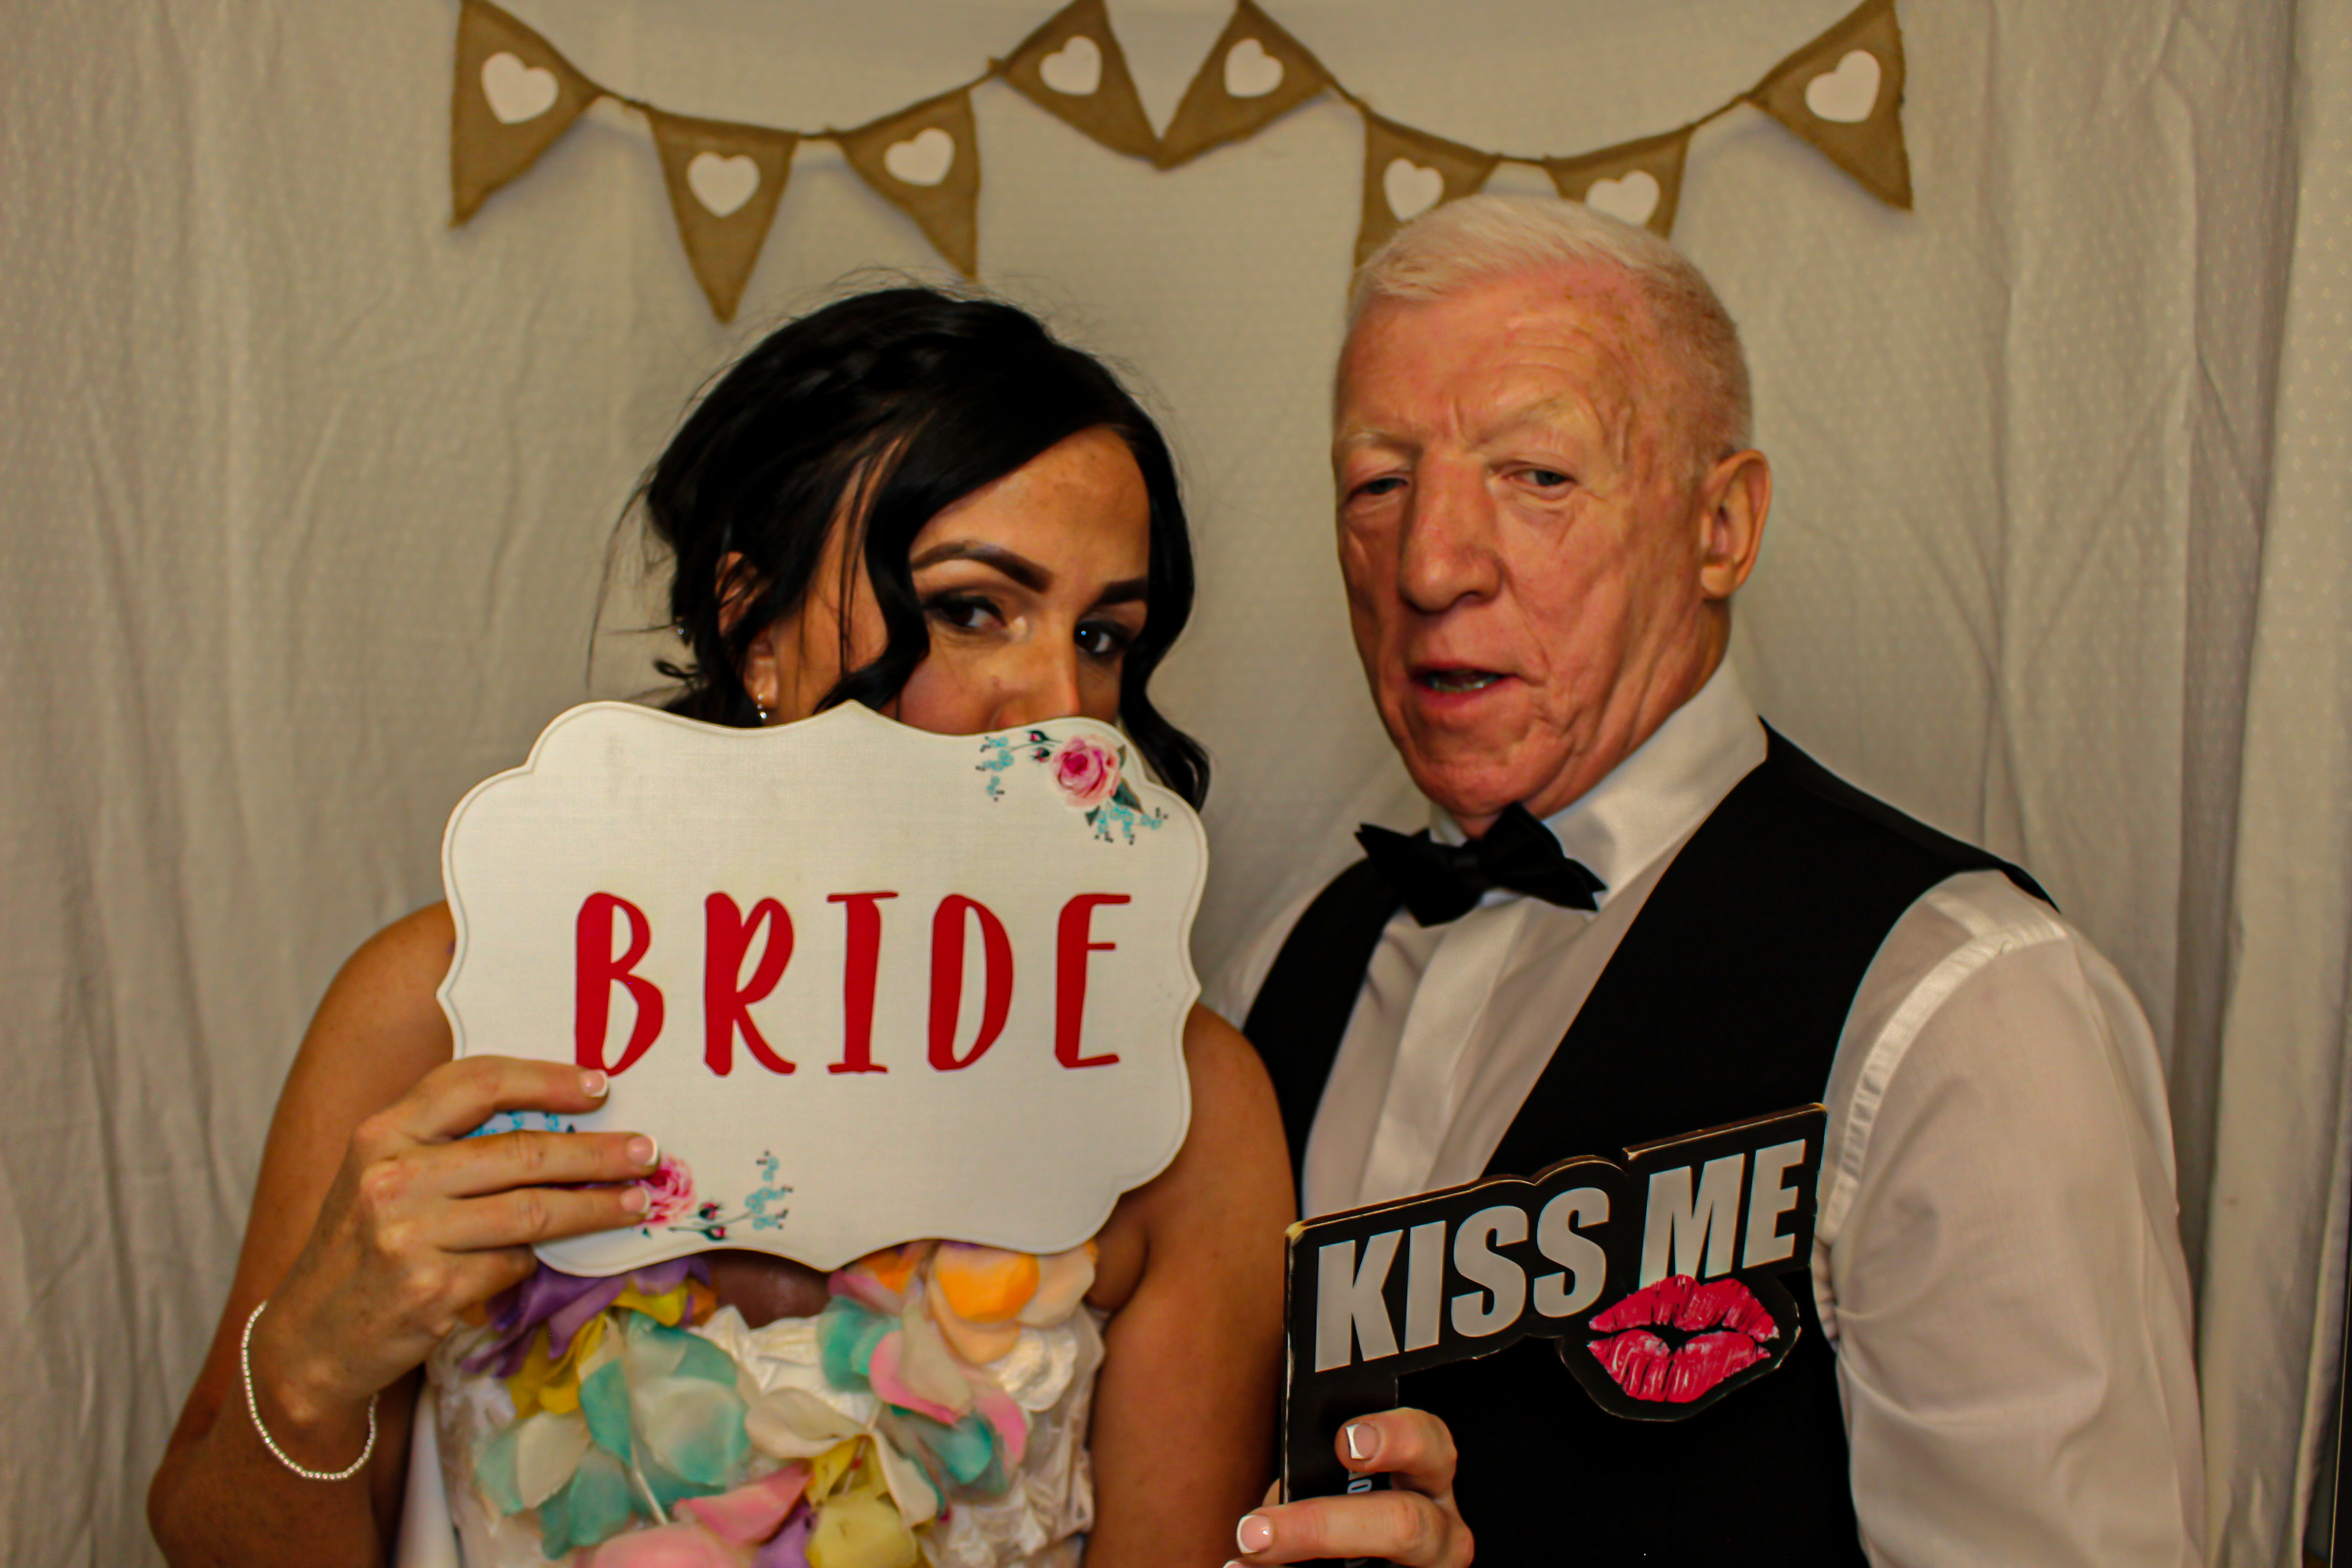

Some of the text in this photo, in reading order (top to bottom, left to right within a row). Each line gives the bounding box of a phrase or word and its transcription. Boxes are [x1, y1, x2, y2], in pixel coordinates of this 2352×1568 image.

[574, 890, 1133, 1077] BRIDE
[1314, 1139, 1807, 1373] KISS ME
